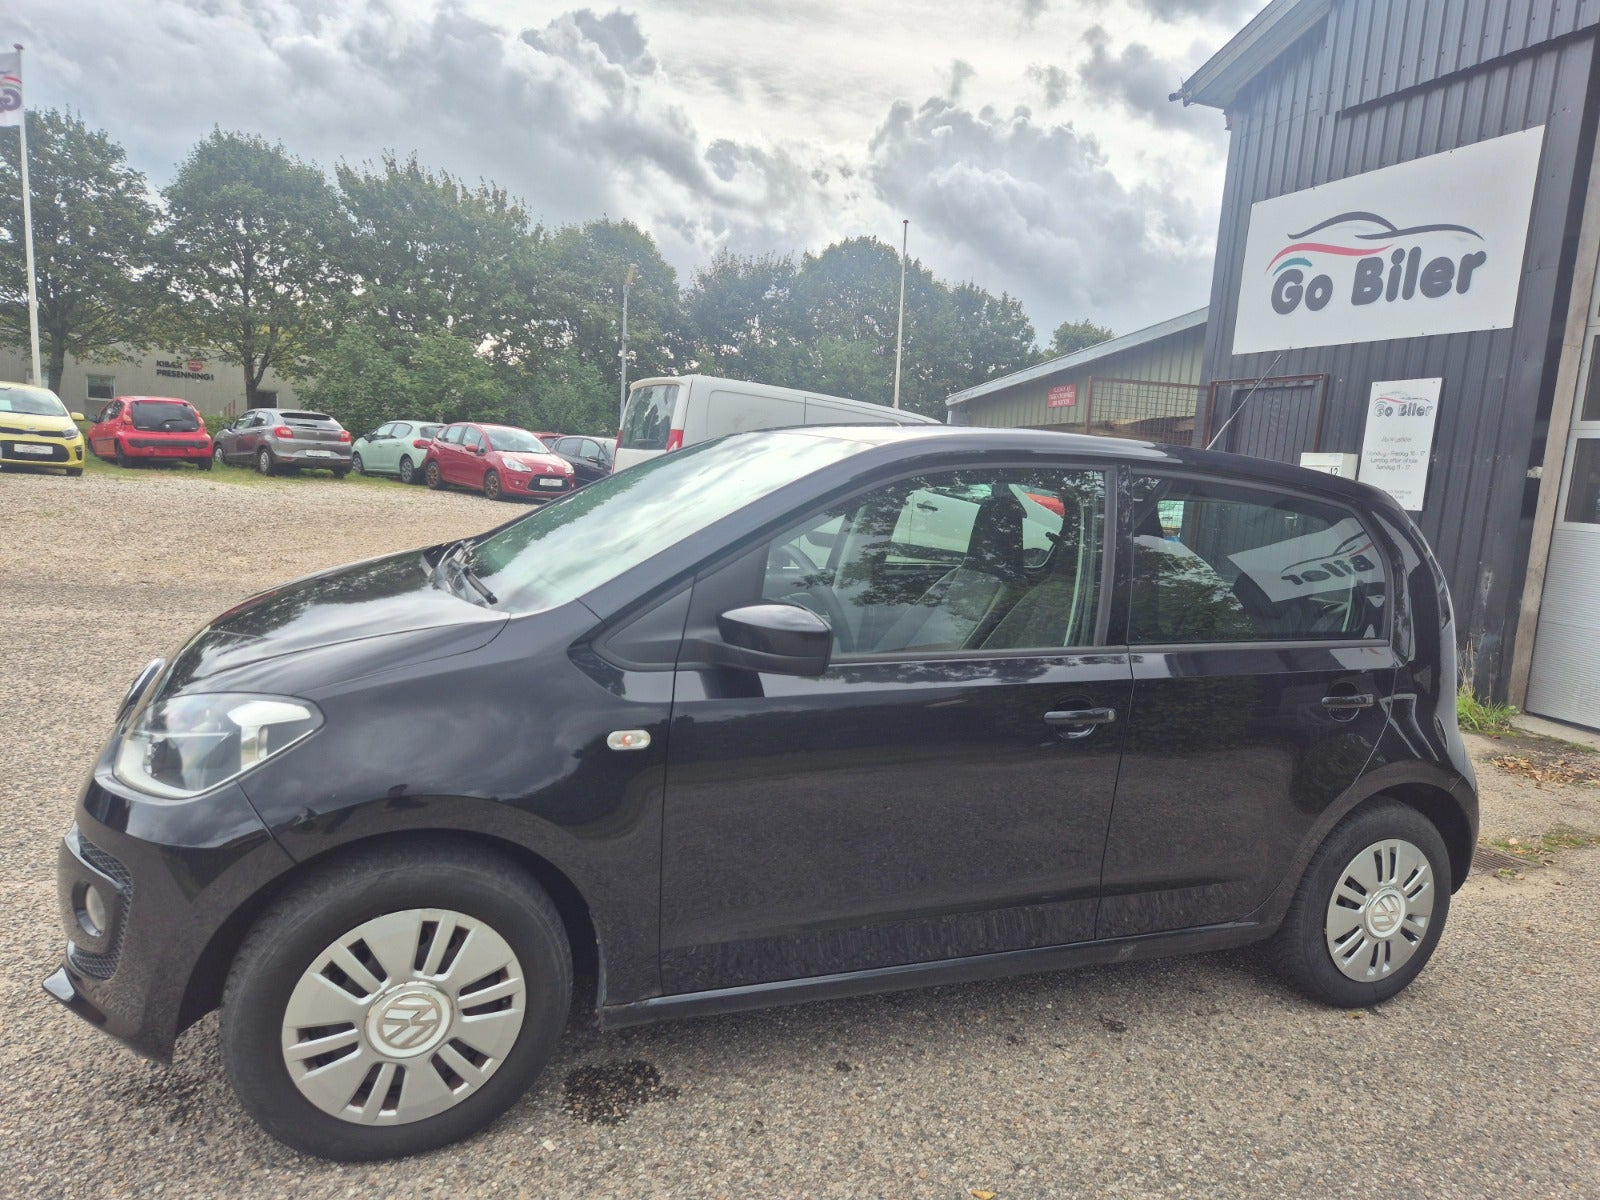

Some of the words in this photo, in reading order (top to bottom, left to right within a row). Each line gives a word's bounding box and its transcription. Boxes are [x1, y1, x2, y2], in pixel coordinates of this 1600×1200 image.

[1271, 268, 1333, 315] Go
[1351, 246, 1487, 306] Biler
[1398, 402, 1434, 417] Biler
